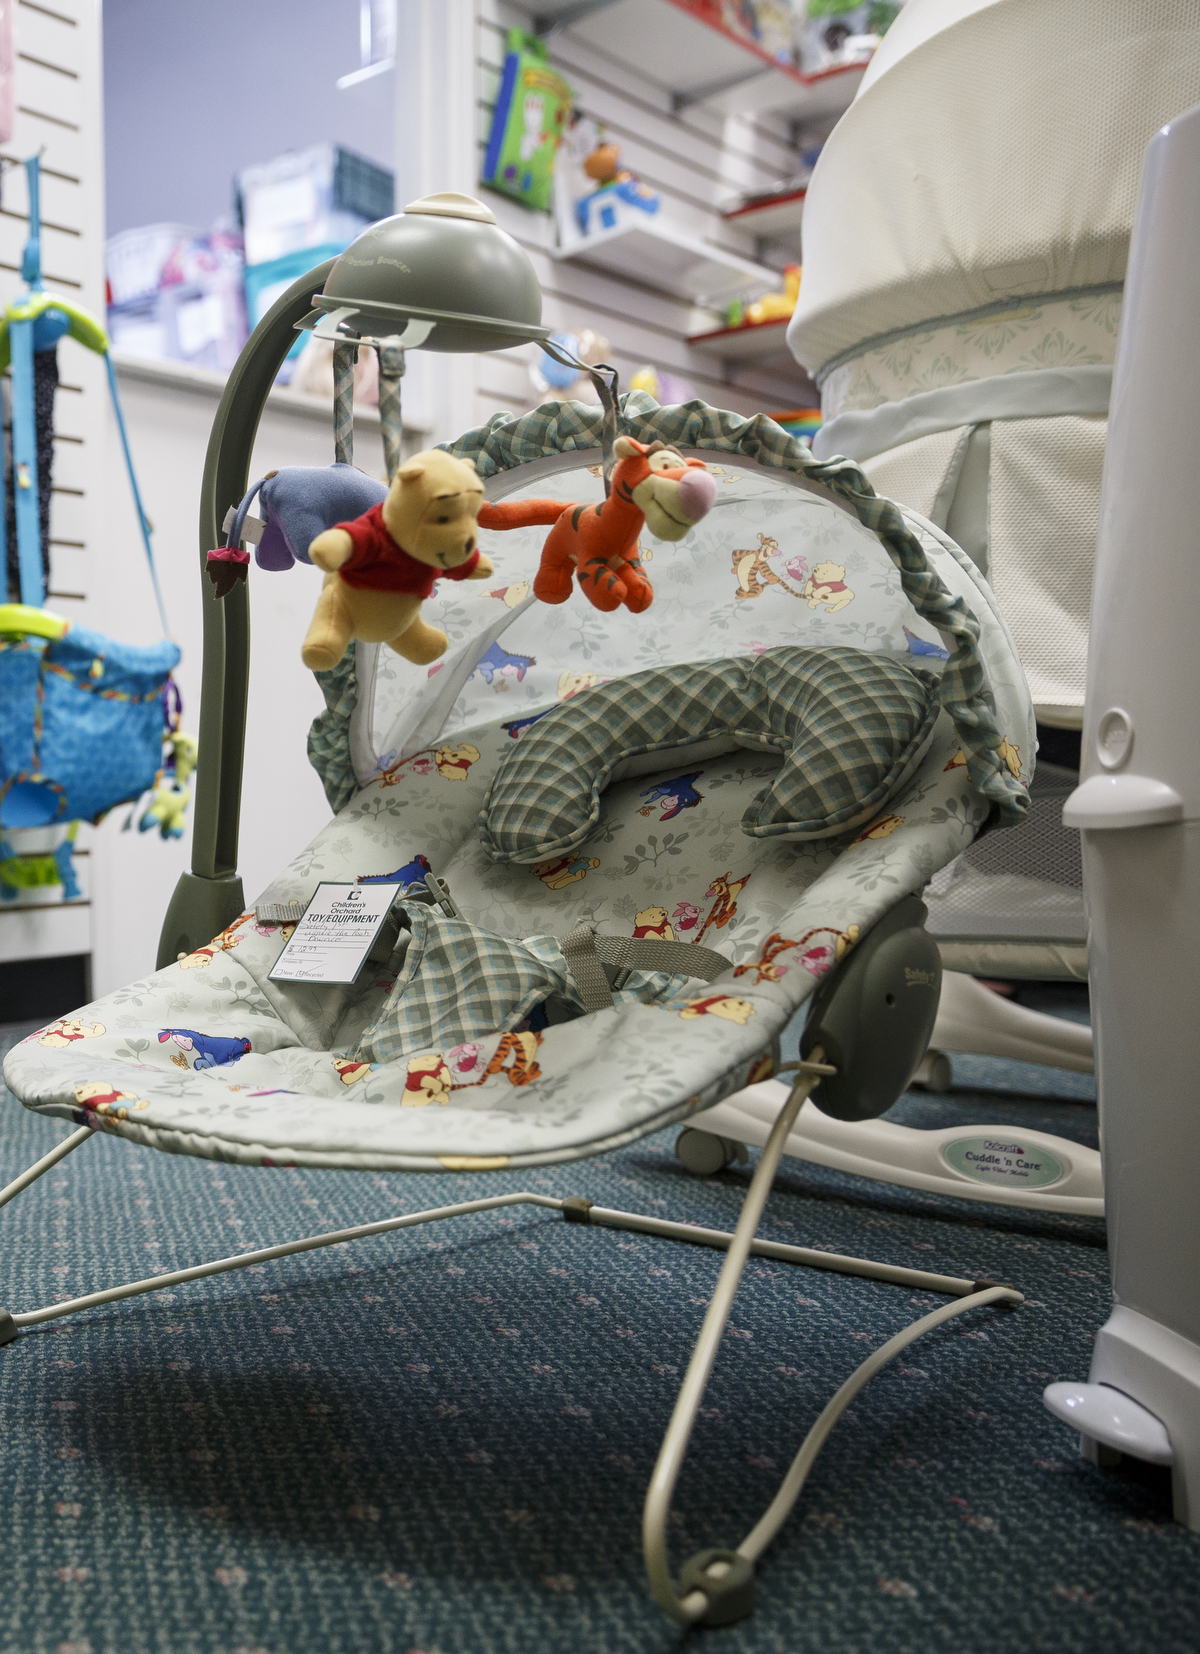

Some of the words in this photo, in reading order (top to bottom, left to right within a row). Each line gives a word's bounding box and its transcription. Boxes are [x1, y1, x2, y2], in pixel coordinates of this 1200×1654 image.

[377, 255, 411, 274] Bouncer
[307, 914, 380, 923] TOY/EQUIPMENT
[965, 1151, 1001, 1165] Cuddle
[1003, 1156, 1013, 1166] 'n
[1015, 1159, 1041, 1171] Care
